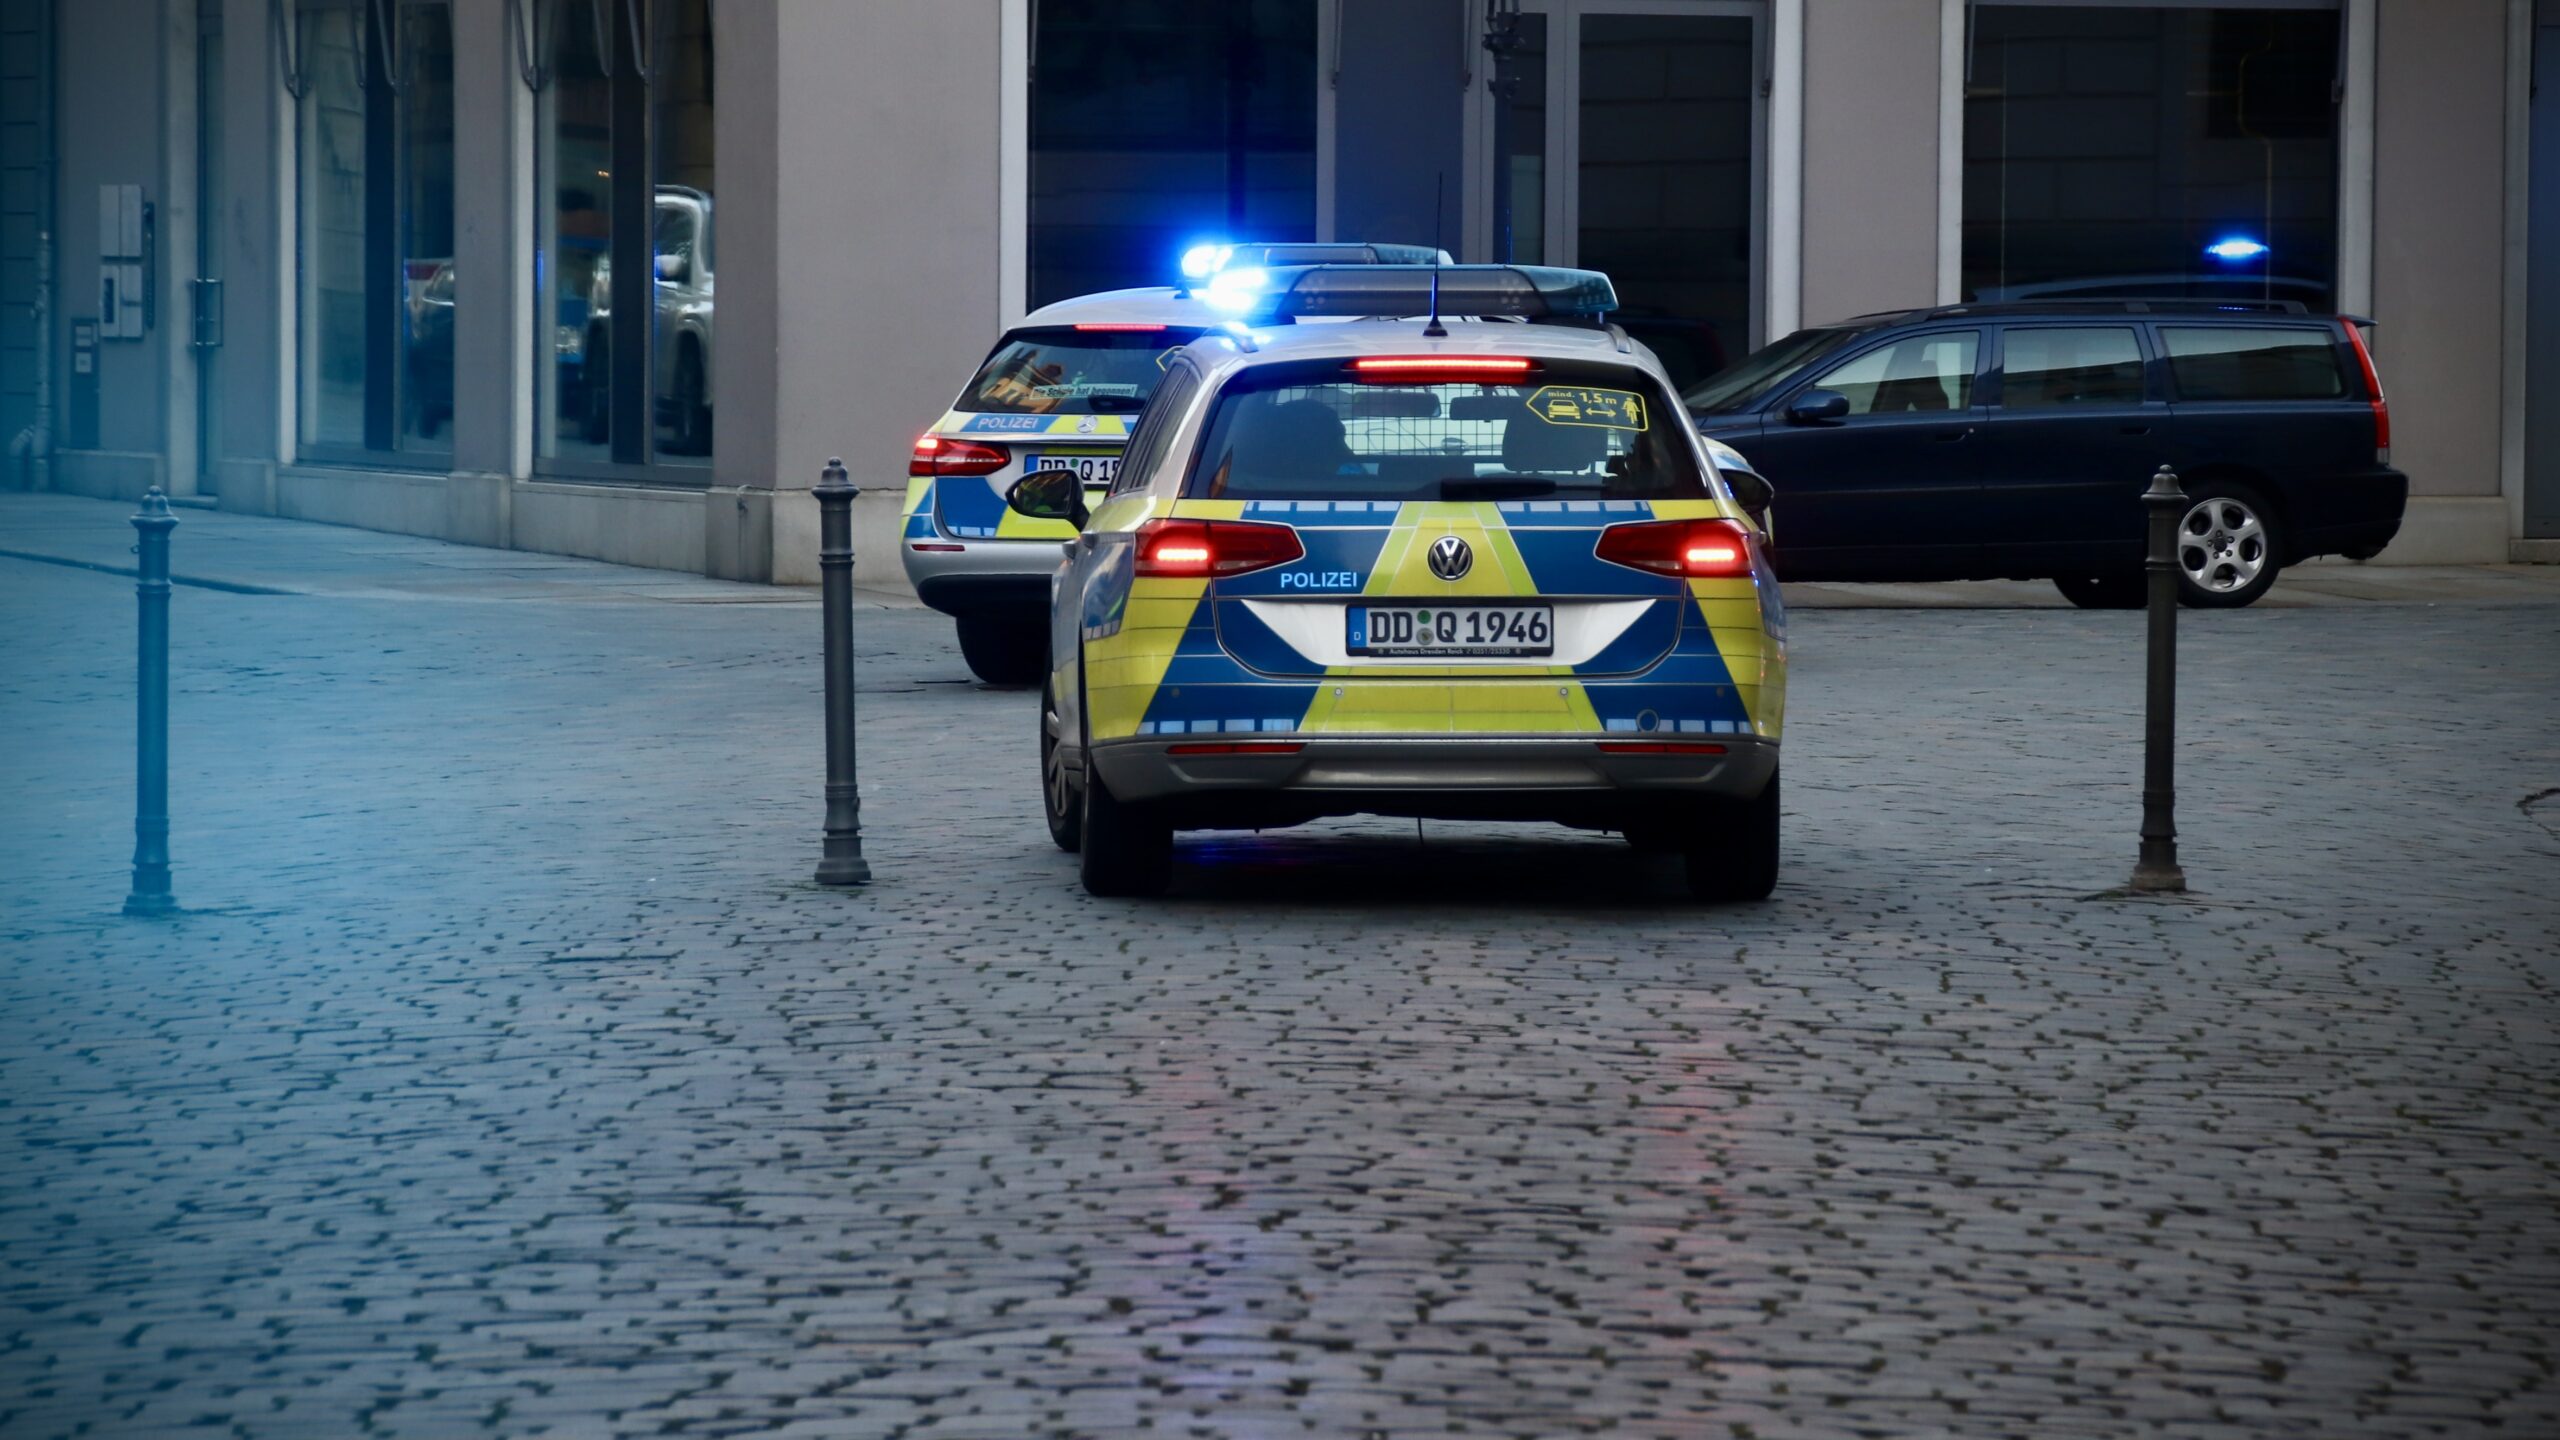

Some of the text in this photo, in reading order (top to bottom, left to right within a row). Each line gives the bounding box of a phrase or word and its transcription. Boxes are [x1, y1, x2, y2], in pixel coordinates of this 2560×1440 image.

[1579, 392, 1602, 404] 1,5
[1605, 397, 1618, 405] m
[977, 417, 1038, 430] POLIZEI
[1081, 460, 1094, 481] Q
[1280, 572, 1357, 588] POLIZEI
[1370, 612, 1548, 643] DD Q 1946
[1354, 631, 1361, 640] D
